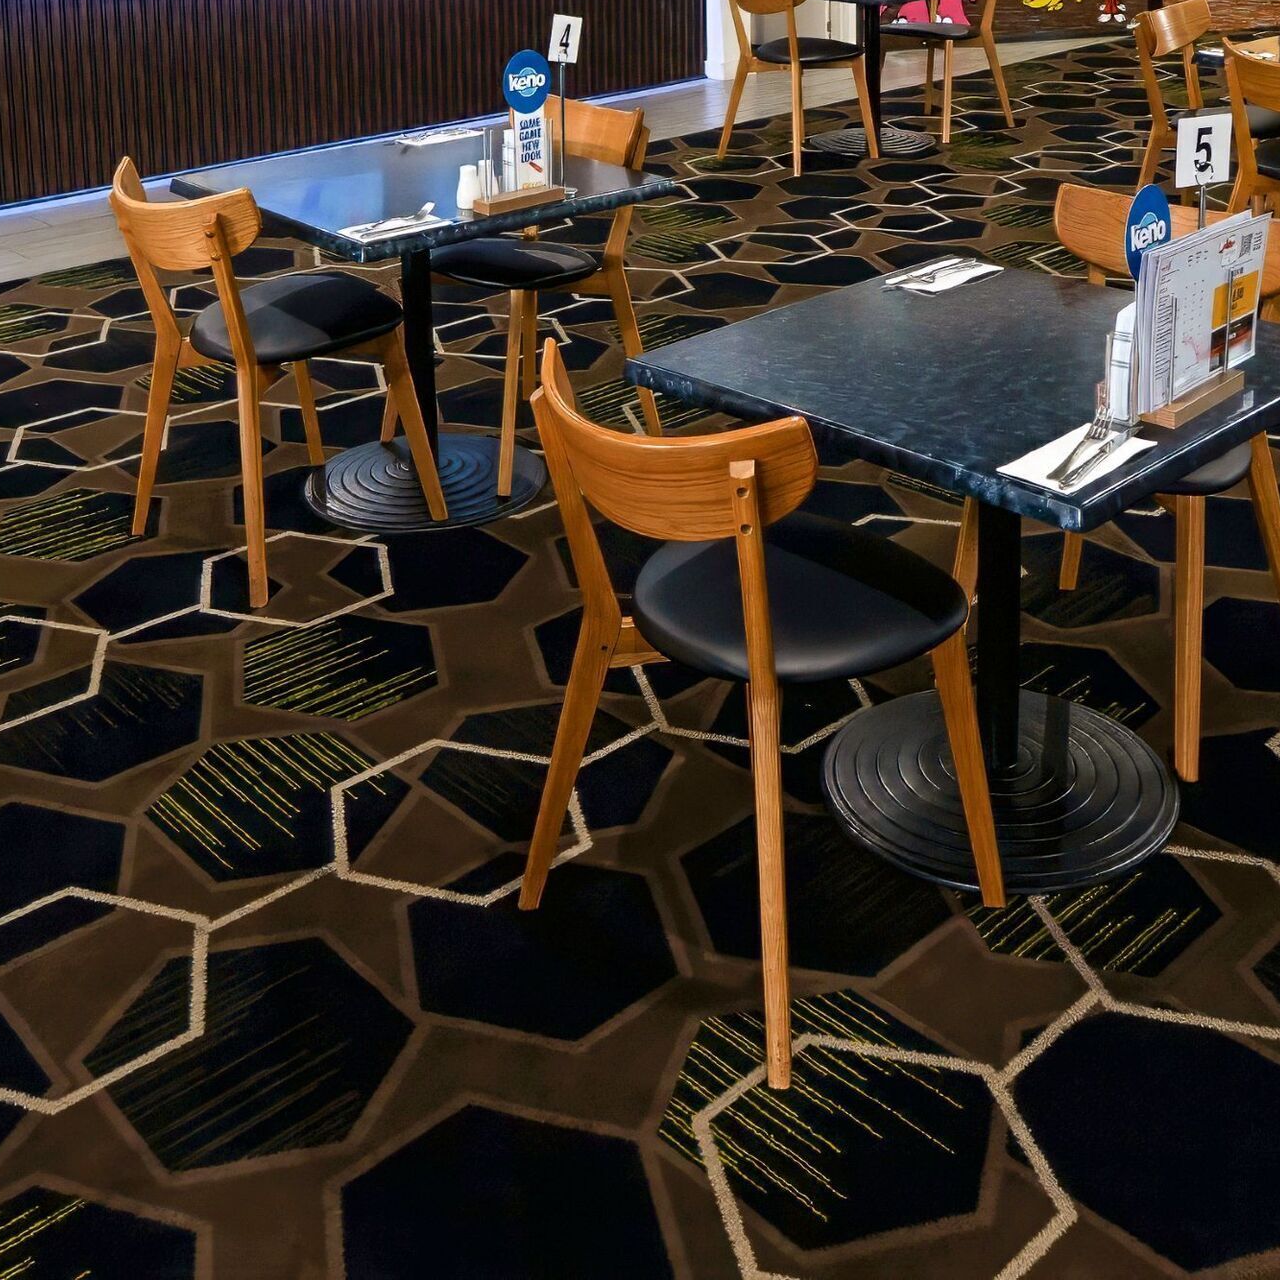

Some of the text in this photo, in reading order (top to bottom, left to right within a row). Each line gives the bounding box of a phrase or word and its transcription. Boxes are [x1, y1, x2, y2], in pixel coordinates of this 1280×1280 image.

[559, 23, 572, 49] 4
[521, 150, 542, 163] LOOK
[1194, 126, 1213, 172] 5
